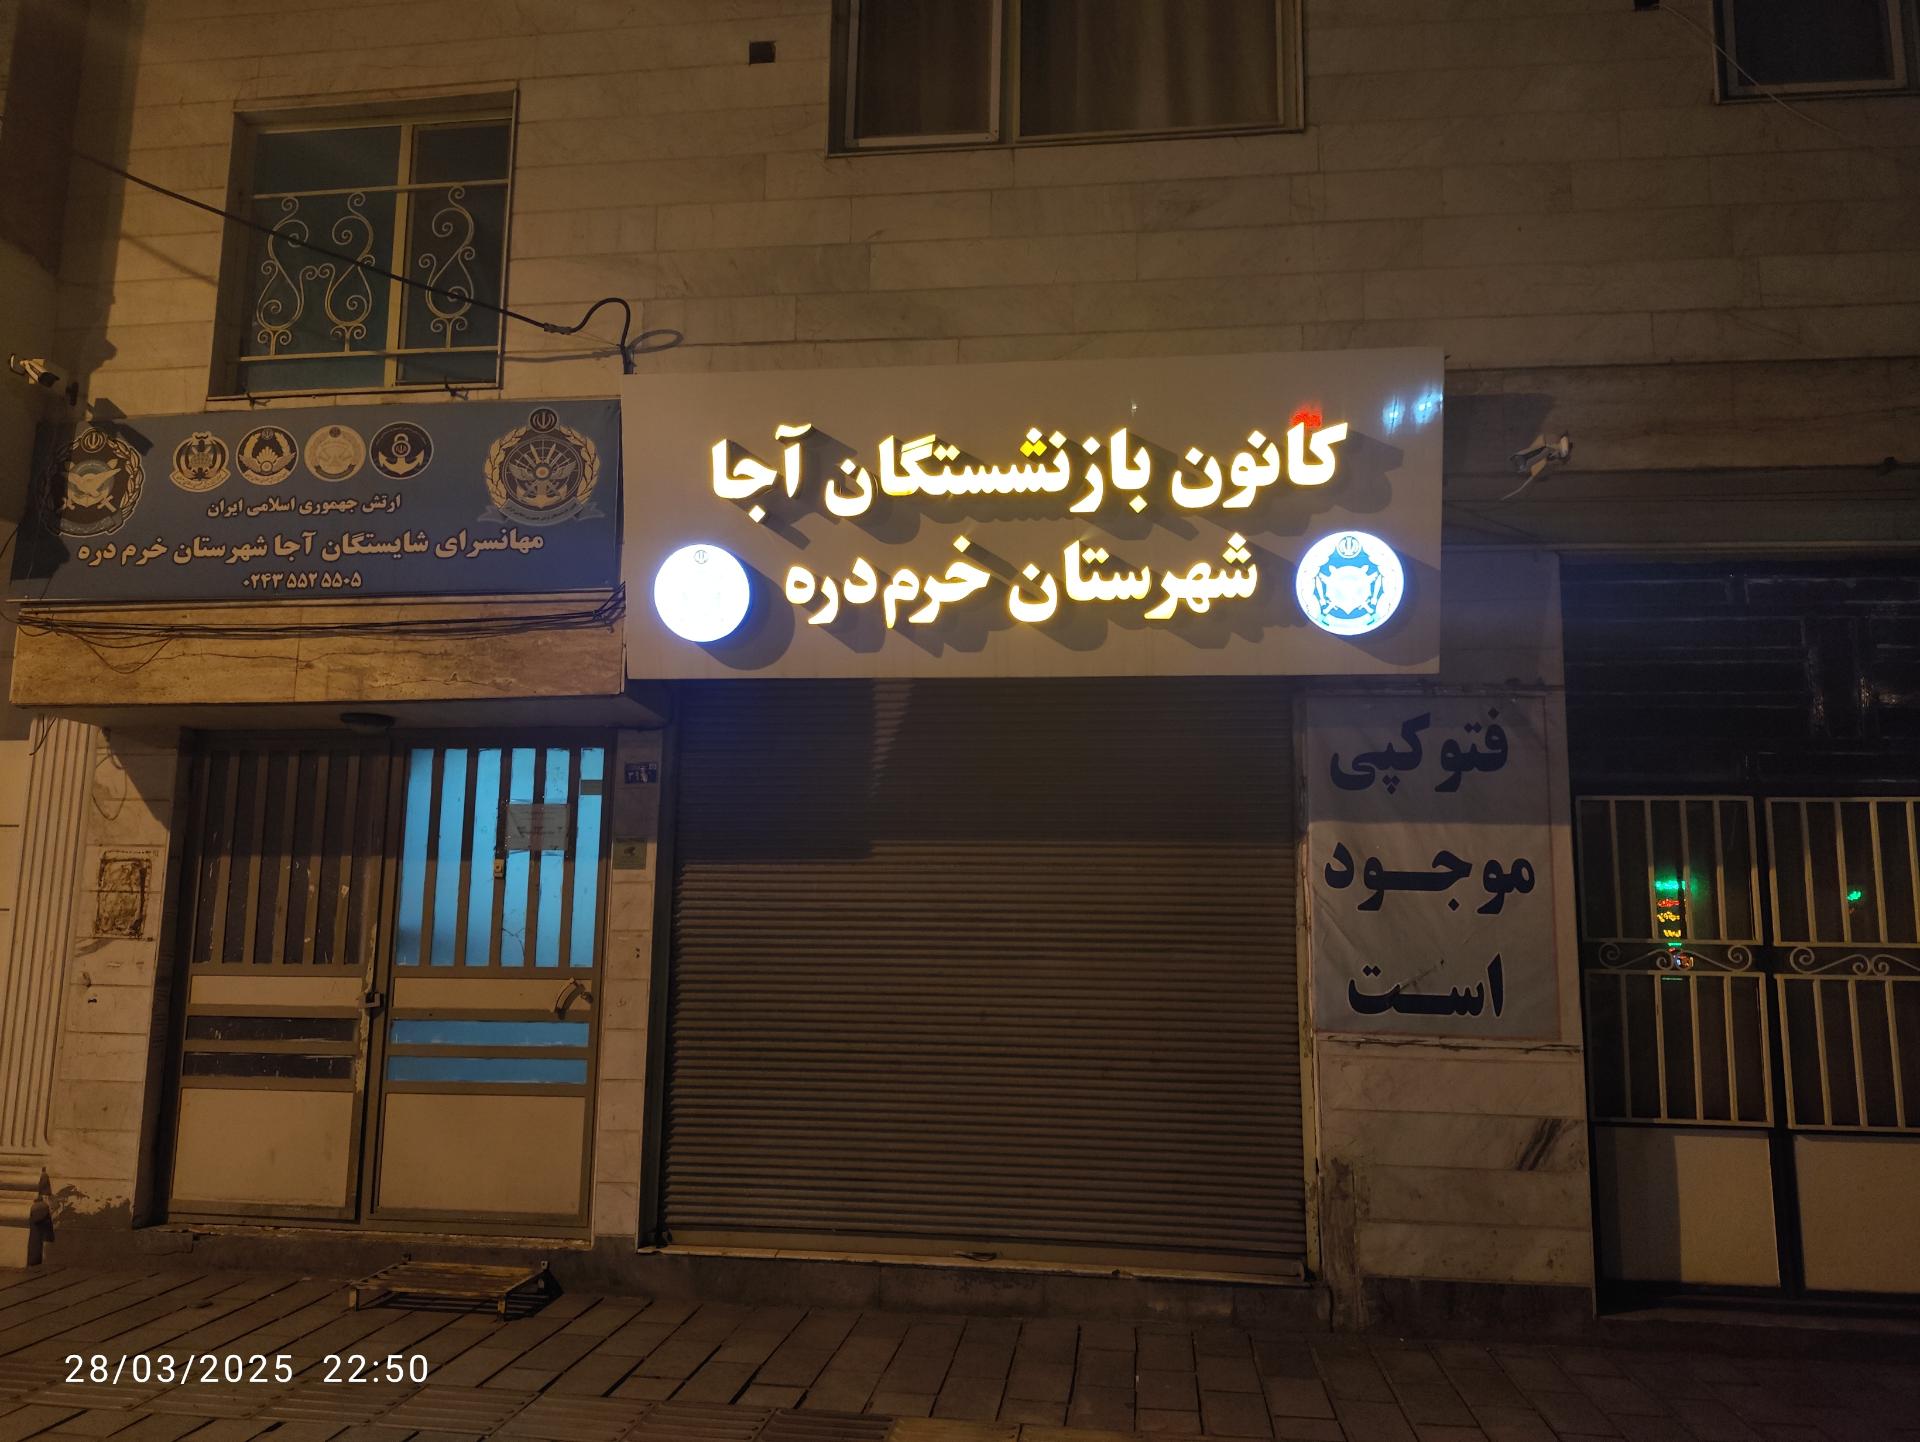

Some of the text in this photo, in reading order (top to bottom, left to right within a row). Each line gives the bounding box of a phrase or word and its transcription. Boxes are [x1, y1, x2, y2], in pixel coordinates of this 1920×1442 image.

[711, 421, 1348, 524] کانون بازنشستگان آجا
[207, 497, 244, 518] ایران
[246, 496, 296, 516] اسلامی
[361, 494, 401, 513] ارتش
[173, 535, 268, 564] شهرستان
[274, 531, 317, 562] آجا
[321, 529, 429, 562] شایستگان
[1008, 532, 1258, 623] شهرستان
[1324, 842, 1536, 915] موجود
[1348, 952, 1505, 1018] است
